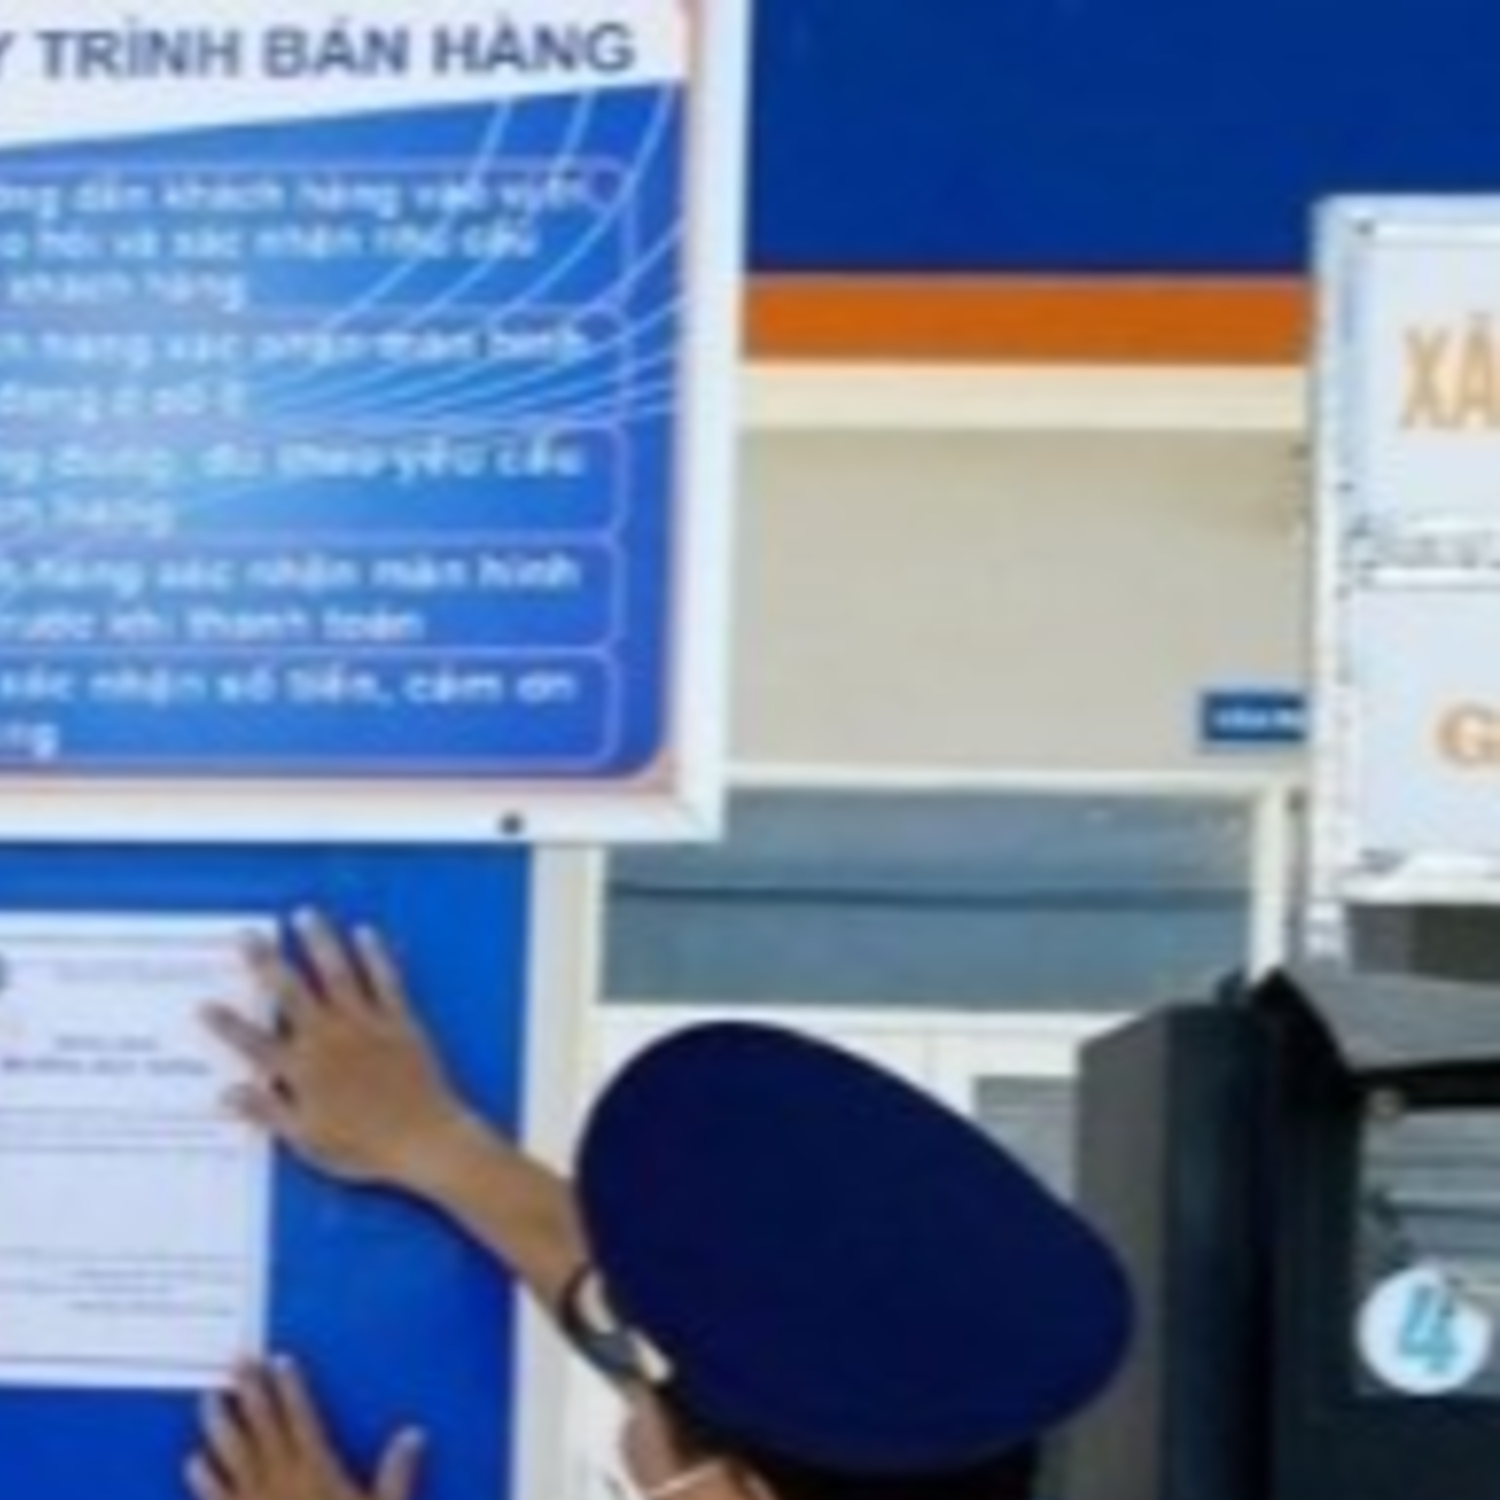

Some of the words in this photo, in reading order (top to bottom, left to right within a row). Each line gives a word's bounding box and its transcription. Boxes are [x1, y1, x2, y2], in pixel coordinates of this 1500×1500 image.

[37, 14, 242, 78] TRÌNH
[262, 16, 410, 77] BÁN
[432, 17, 637, 75] HÀNG
[1395, 1280, 1465, 1375] 4
